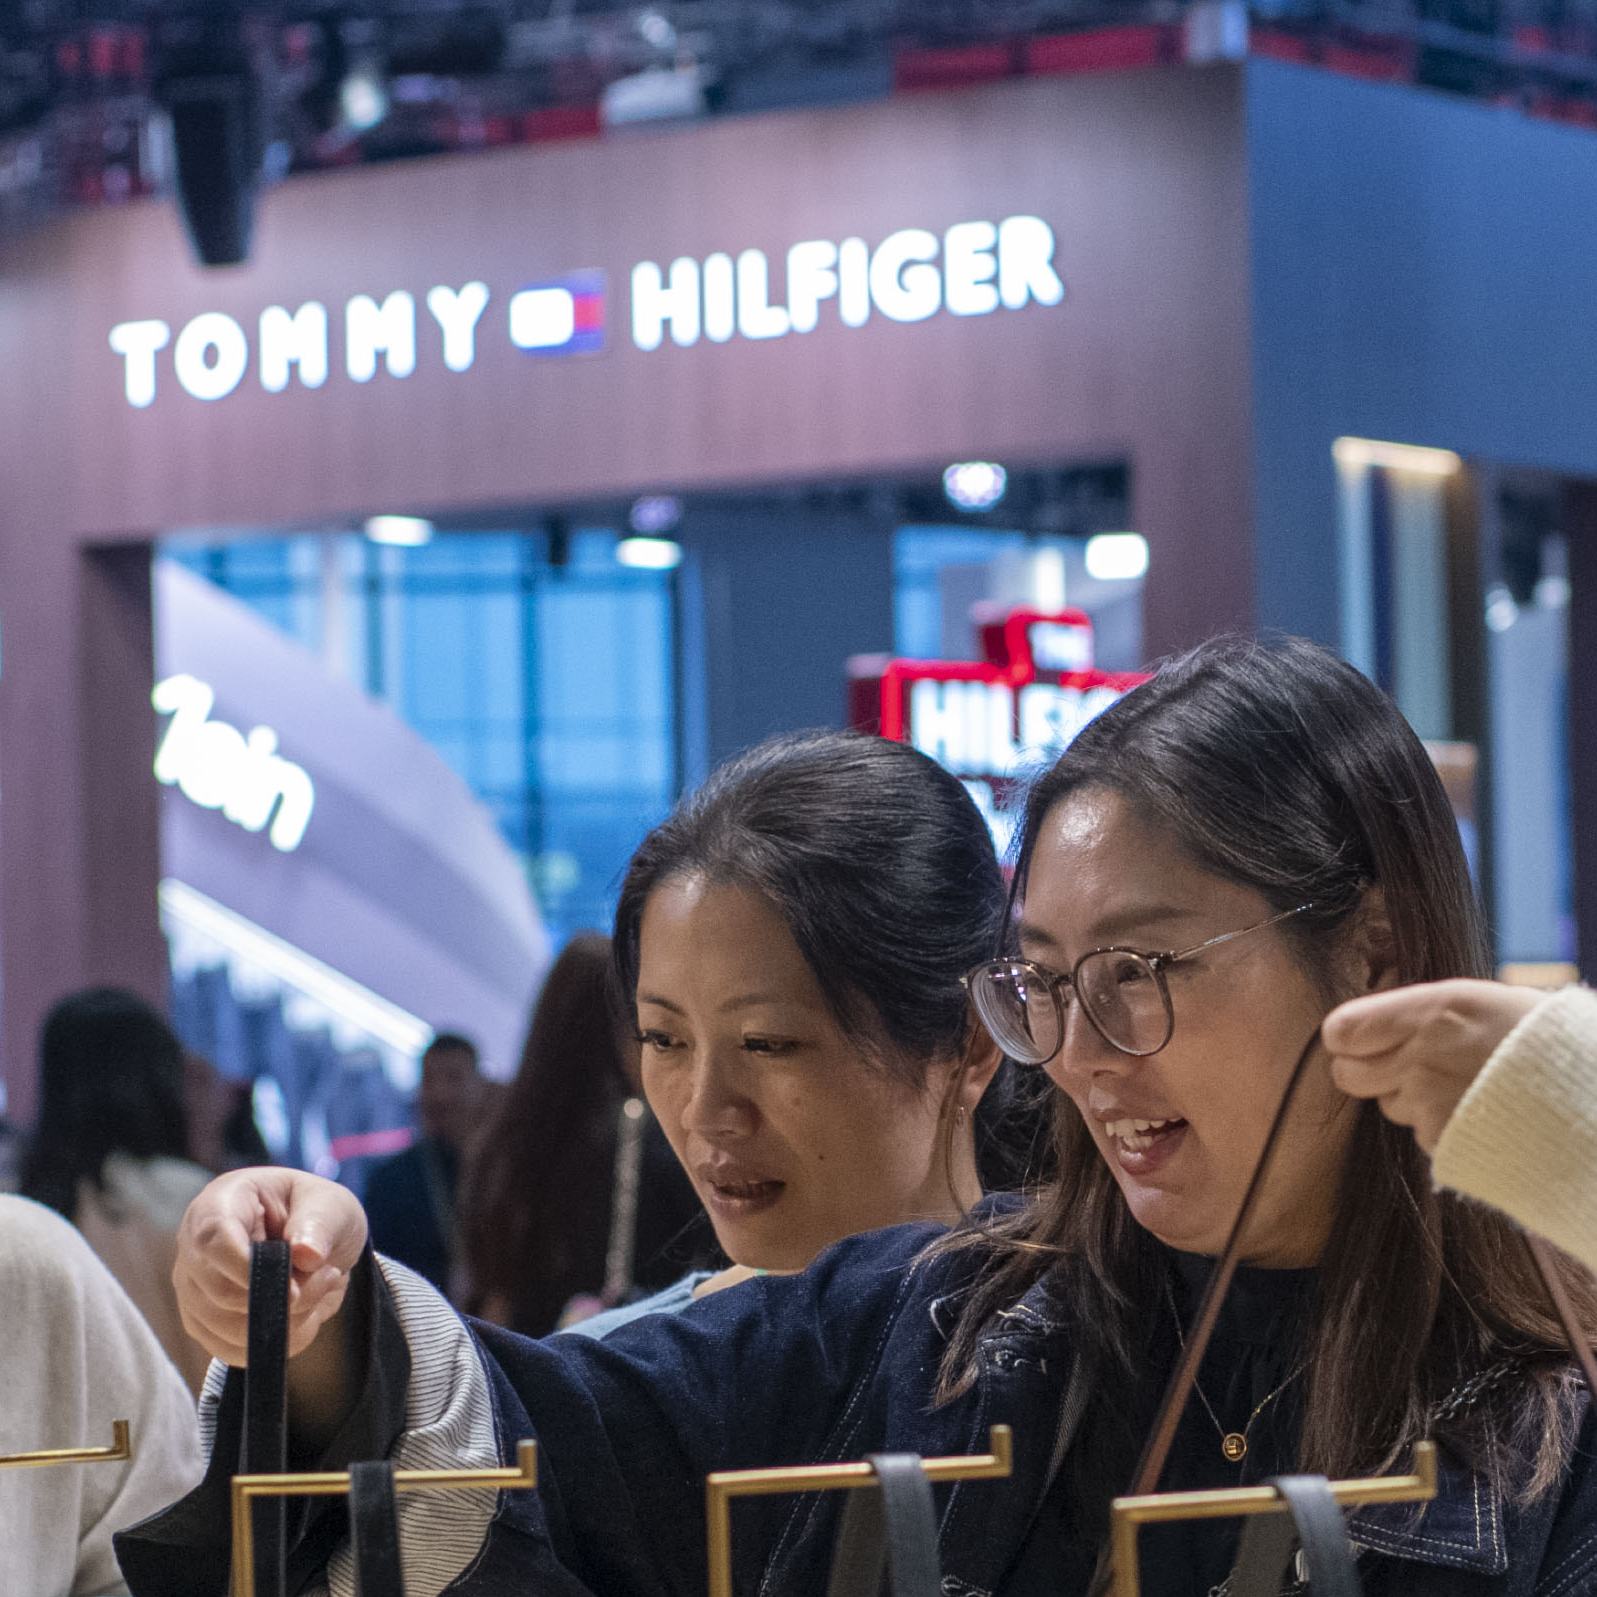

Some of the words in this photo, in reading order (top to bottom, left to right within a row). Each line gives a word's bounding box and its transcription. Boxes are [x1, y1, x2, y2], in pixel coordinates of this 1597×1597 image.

[107, 281, 491, 408] TOMMY
[629, 214, 1066, 352] HILFIGER
[151, 674, 316, 853] lein
